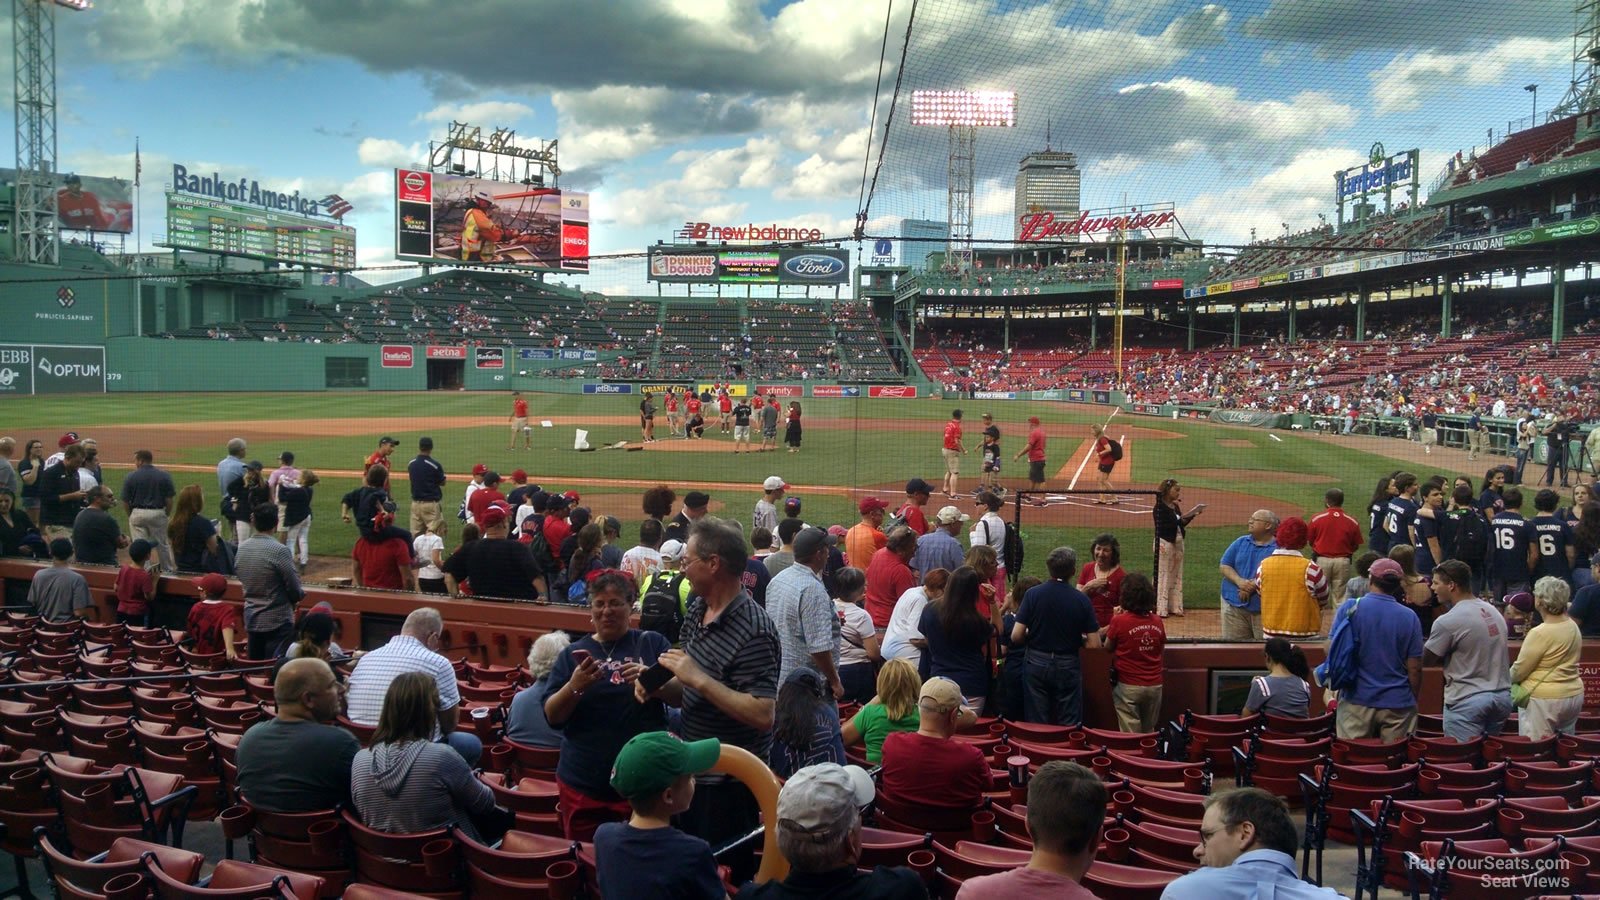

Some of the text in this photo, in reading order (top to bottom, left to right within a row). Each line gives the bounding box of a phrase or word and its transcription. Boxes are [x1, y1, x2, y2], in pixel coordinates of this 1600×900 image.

[1338, 159, 1411, 197] Cumberland
[173, 163, 319, 217] Bank of America
[1019, 207, 1175, 241] Budweiser
[711, 226, 747, 241] new
[749, 223, 821, 241] balance
[564, 237, 588, 246] ENEOS
[1472, 239, 1489, 251] AND
[1490, 236, 1504, 249] ANI
[669, 257, 715, 266] DUNKIN'
[796, 258, 833, 274] Ford
[669, 265, 713, 274] DONUTS
[1210, 284, 1228, 294] STANLEY
[0, 350, 30, 363] EBB
[432, 347, 460, 356] aetna
[564, 350, 580, 359] NESN
[53, 364, 100, 377] OPTUM
[106, 373, 122, 381] 379
[595, 383, 620, 394] jetBlue
[766, 386, 793, 396] xfinity
[1494, 527, 1515, 550] 16
[1540, 534, 1556, 556] 6
[1128, 624, 1151, 635] FENWAY
[1578, 667, 1600, 675] CAU
